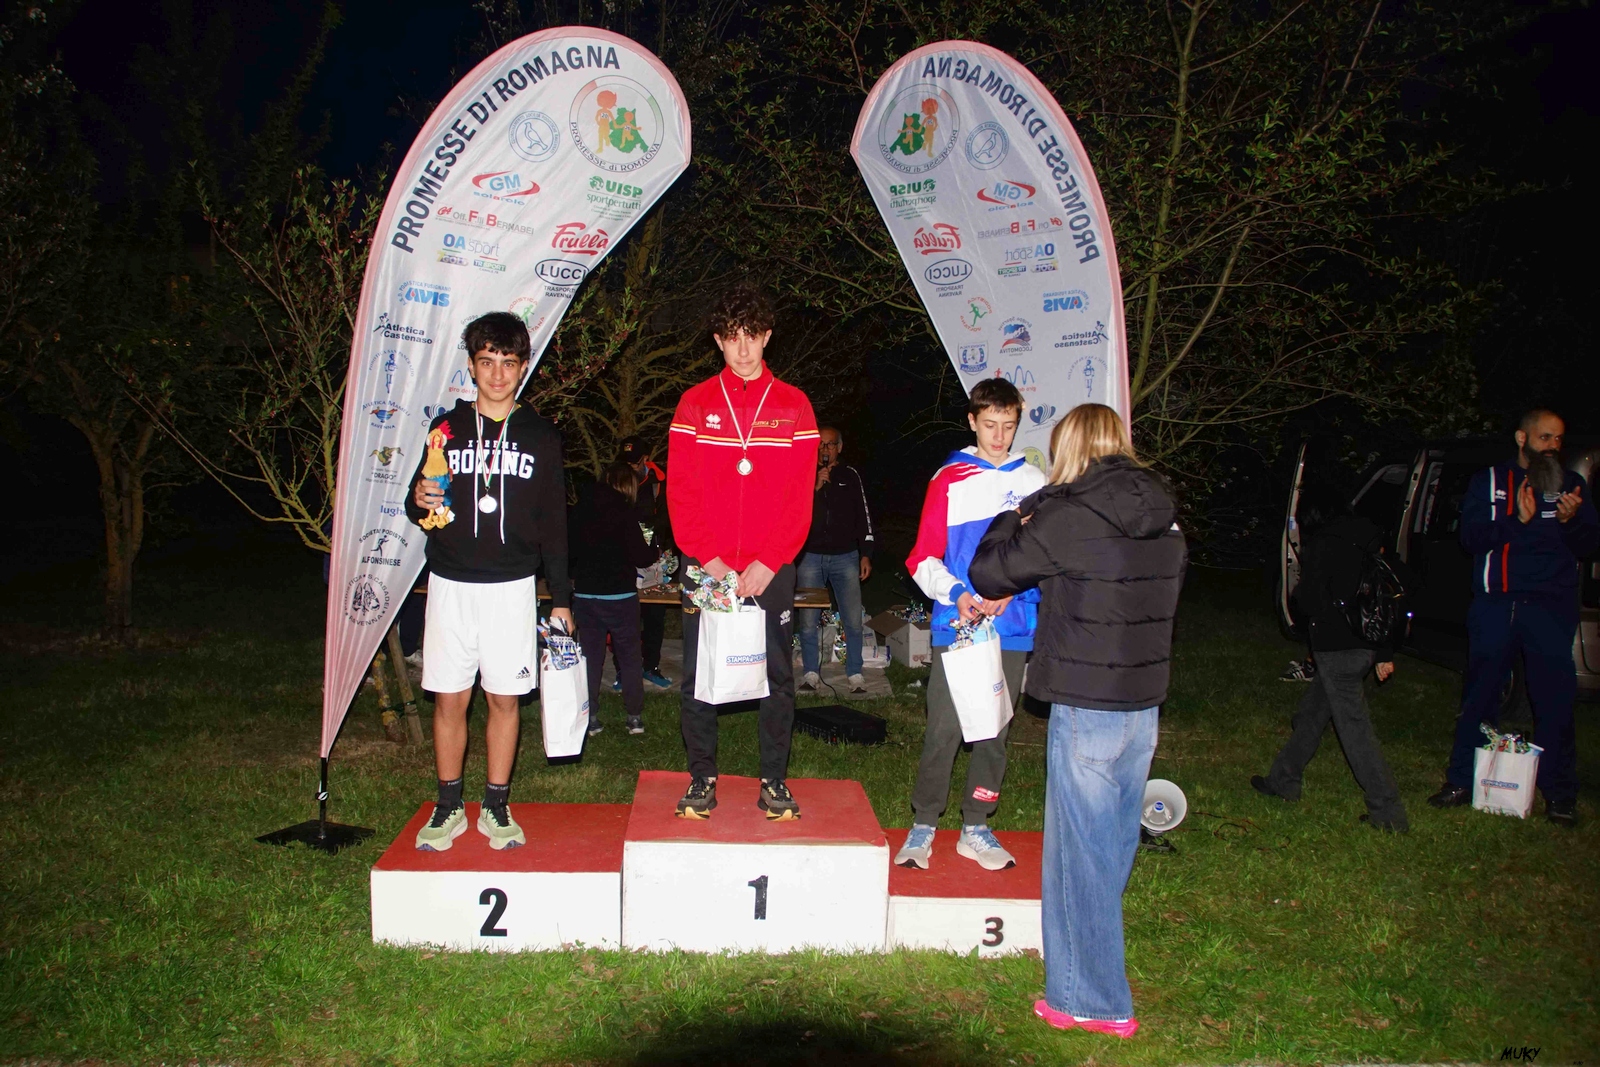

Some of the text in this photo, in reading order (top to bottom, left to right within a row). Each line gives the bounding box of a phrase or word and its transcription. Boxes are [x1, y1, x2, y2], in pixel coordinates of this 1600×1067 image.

[391, 45, 621, 254] PROMESSE DI ROMAGNA
[570, 121, 606, 169] PROMESSE
[620, 141, 660, 171] ROMAGNA
[489, 173, 521, 191] GM
[605, 179, 643, 198] UISP
[473, 191, 525, 205] solarolo
[586, 193, 642, 210] sportpertutti
[485, 213, 534, 235] BERNABEI
[443, 233, 500, 257] OA sport
[551, 222, 609, 249] Frullà
[540, 263, 586, 280] LUCCI
[405, 287, 450, 307] AVIS
[384, 331, 433, 345] Castenaso
[385, 323, 425, 336] Atletica
[468, 439, 518, 450] XREME
[448, 449, 535, 480] BOXING
[361, 556, 401, 566] ALFONSINESE
[747, 874, 769, 920] 1
[478, 887, 509, 937] 2
[981, 917, 1005, 947] 3
